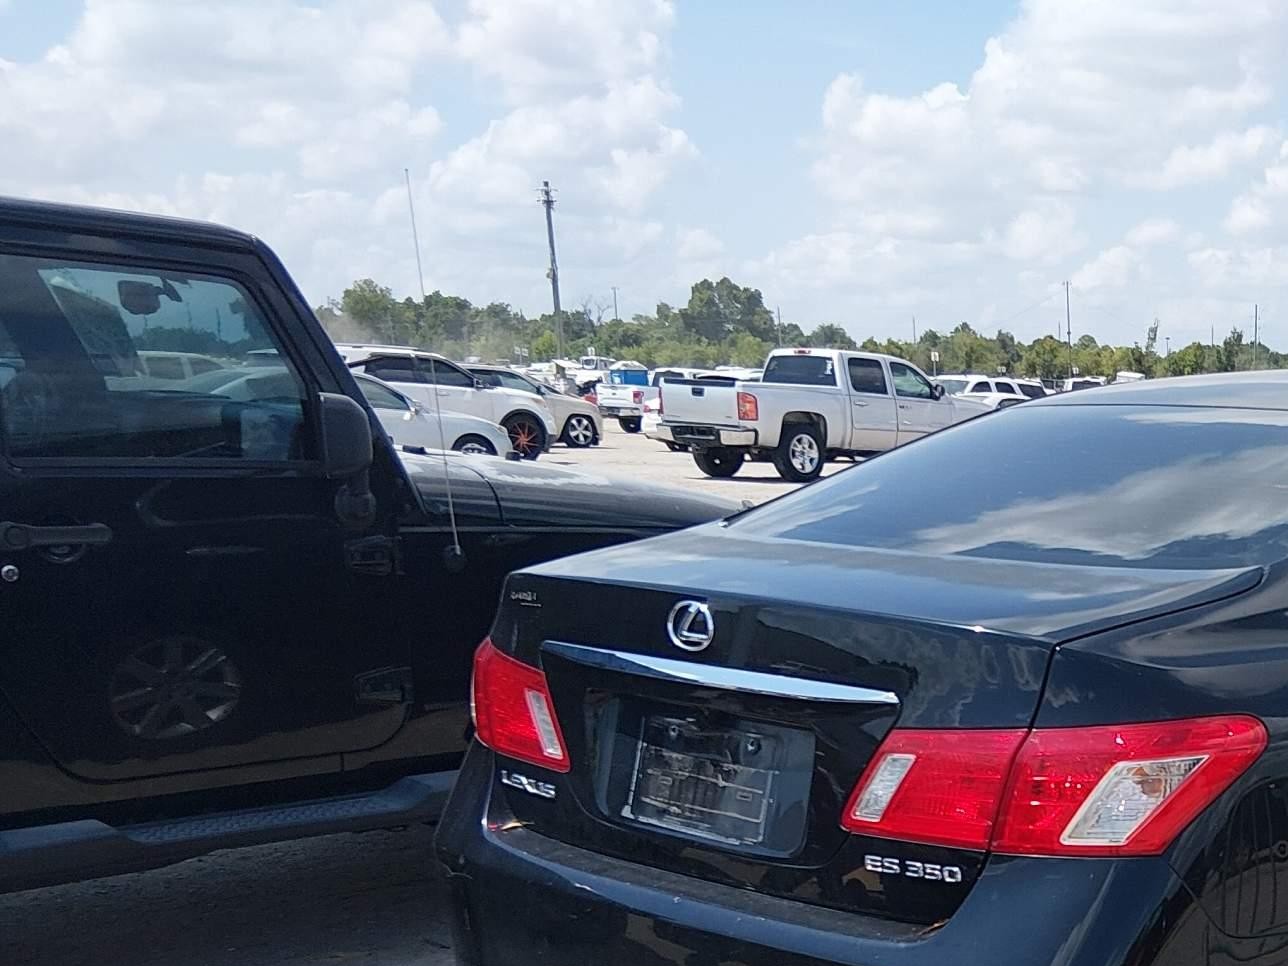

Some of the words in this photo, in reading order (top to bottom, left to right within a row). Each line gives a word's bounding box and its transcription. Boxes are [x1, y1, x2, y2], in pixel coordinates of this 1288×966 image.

[502, 769, 556, 798] LEXUS
[864, 854, 900, 874] ES
[904, 860, 962, 883] 350
